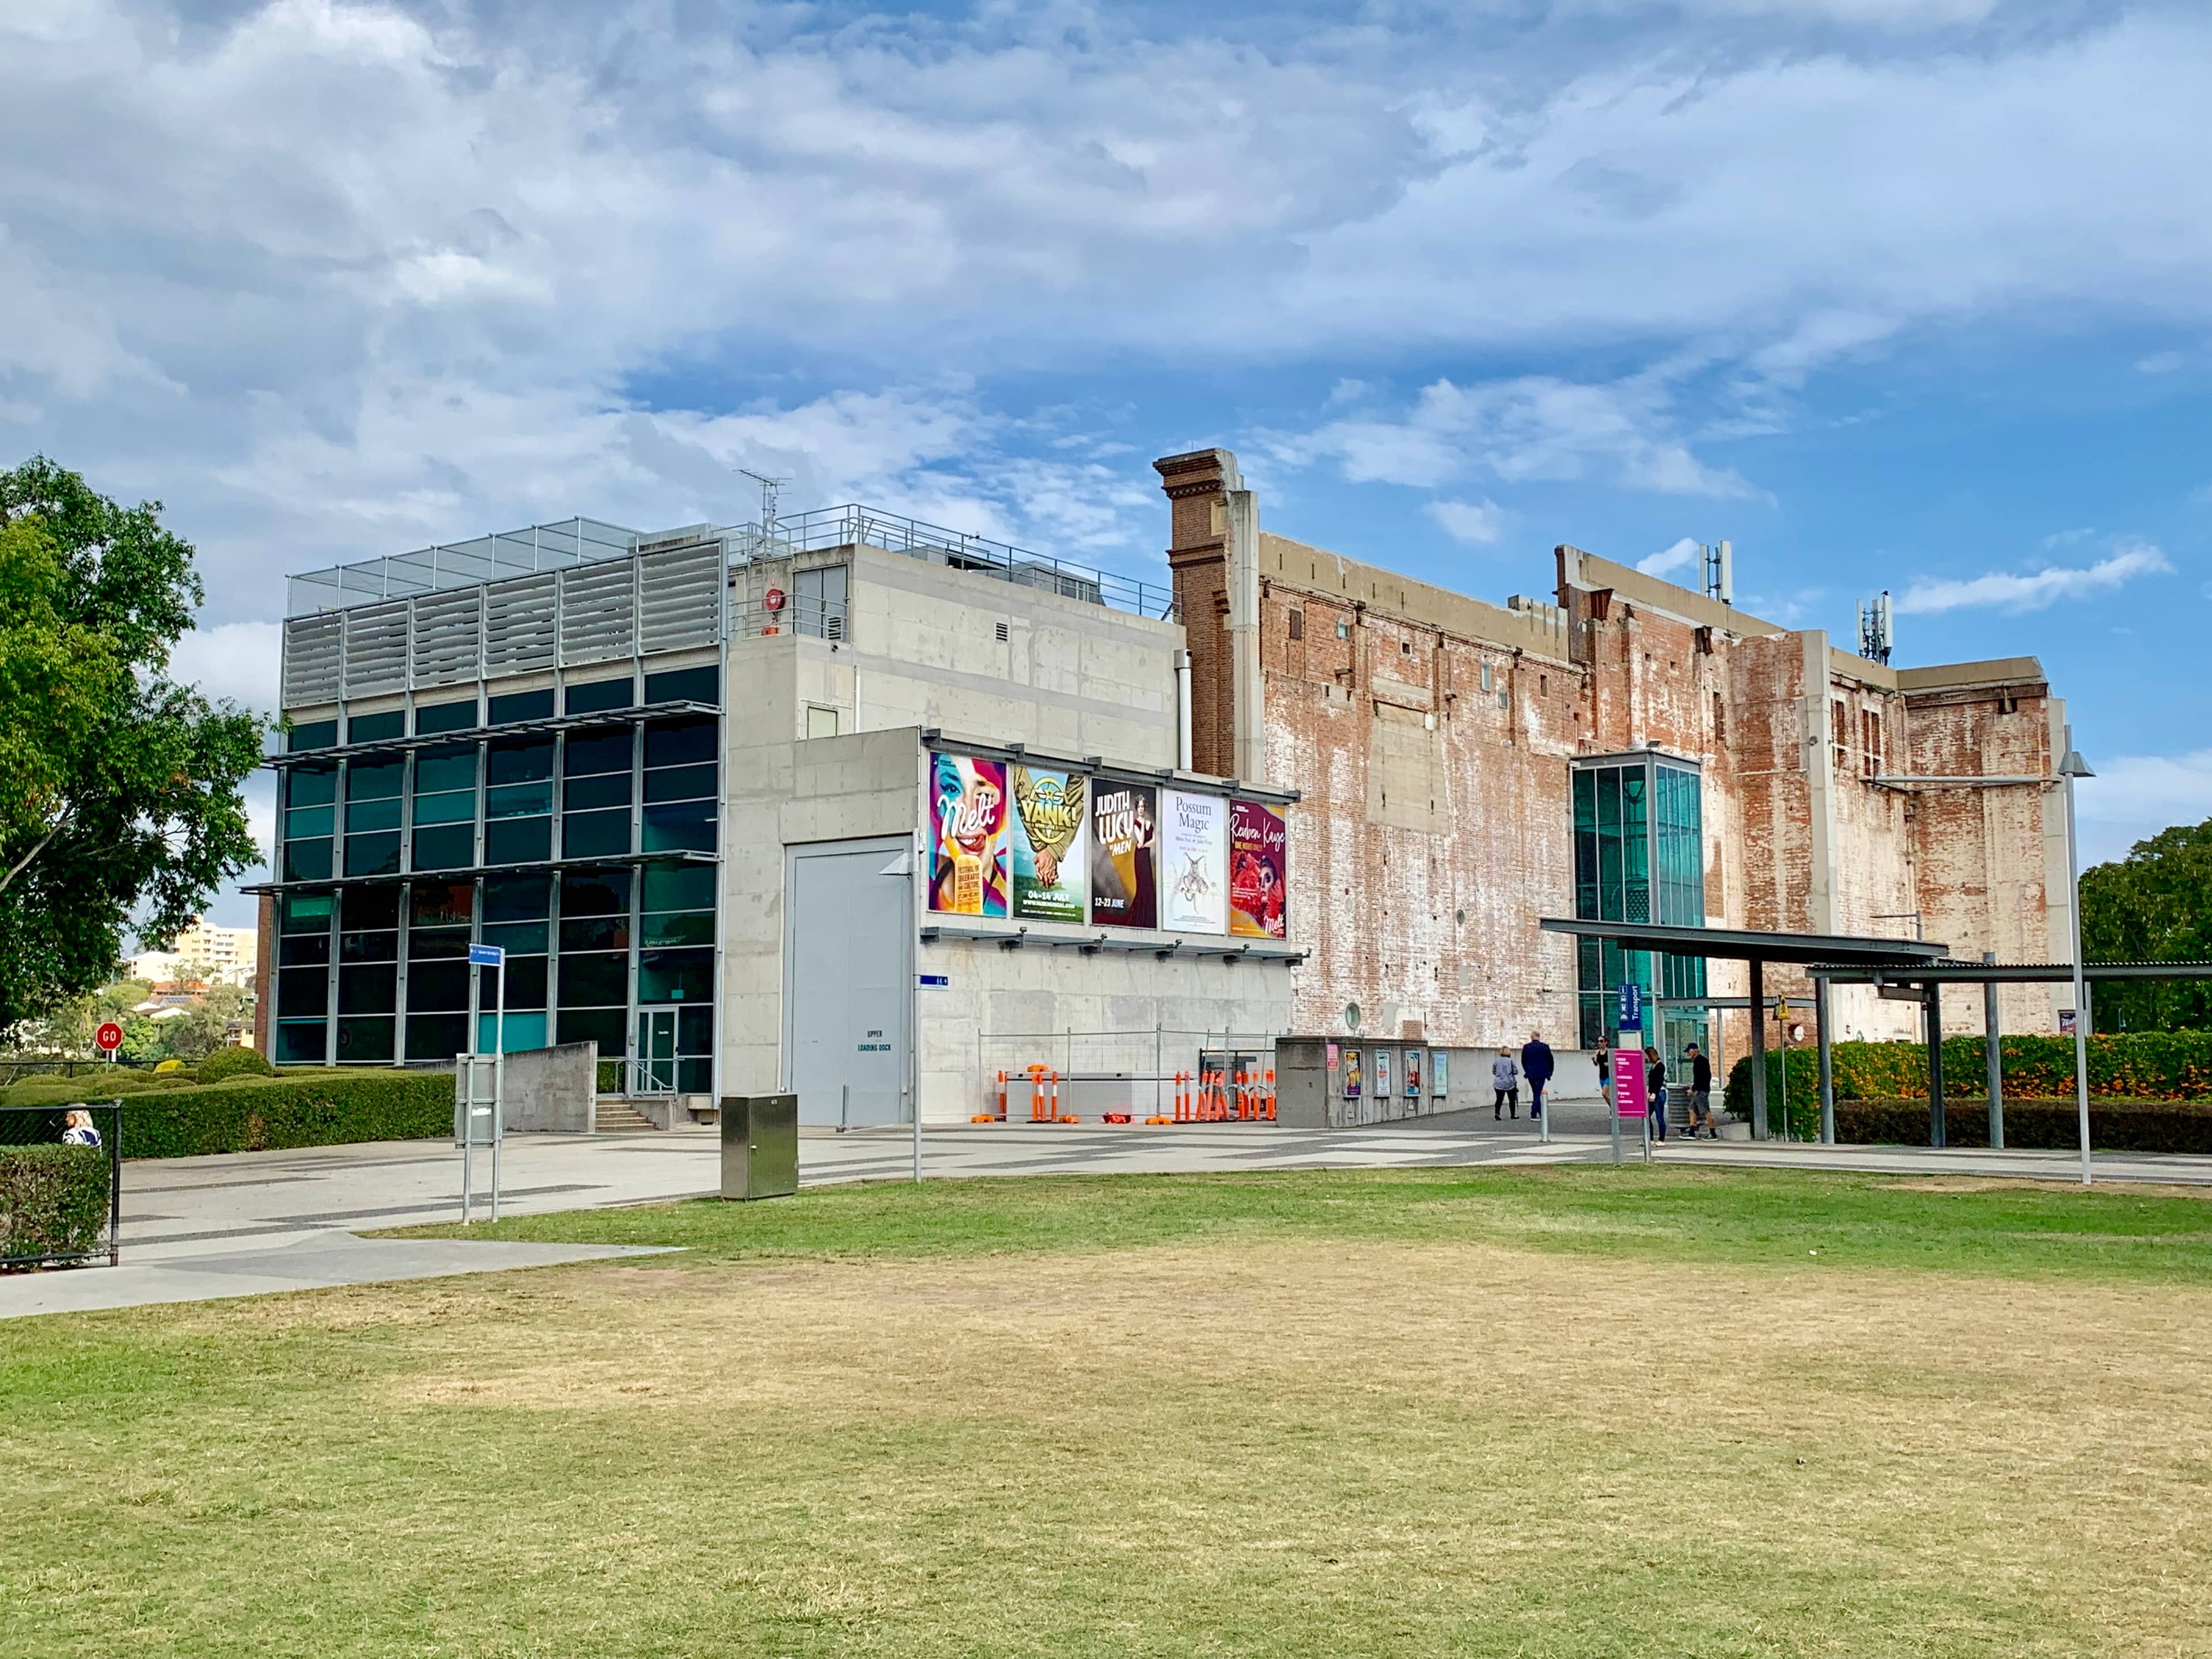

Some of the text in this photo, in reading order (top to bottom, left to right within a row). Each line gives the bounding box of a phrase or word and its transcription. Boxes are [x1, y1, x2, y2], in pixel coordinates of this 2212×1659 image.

[1020, 799, 1077, 828] YANK!
[1095, 790, 1130, 817] JUDITH
[1176, 796, 1212, 816] Possum
[937, 793, 995, 840] Melt
[1099, 810, 1134, 844] LUCY
[1179, 812, 1210, 834] Magic
[1230, 813, 1285, 853] Reuben Kaye
[1112, 839, 1132, 857] MEN
[1028, 890, 1070, 902] 04-14 JULY
[1095, 897, 1124, 908] 12-23 JUNE
[1632, 985, 1640, 1020] Transport
[103, 1031, 116, 1041] GO
